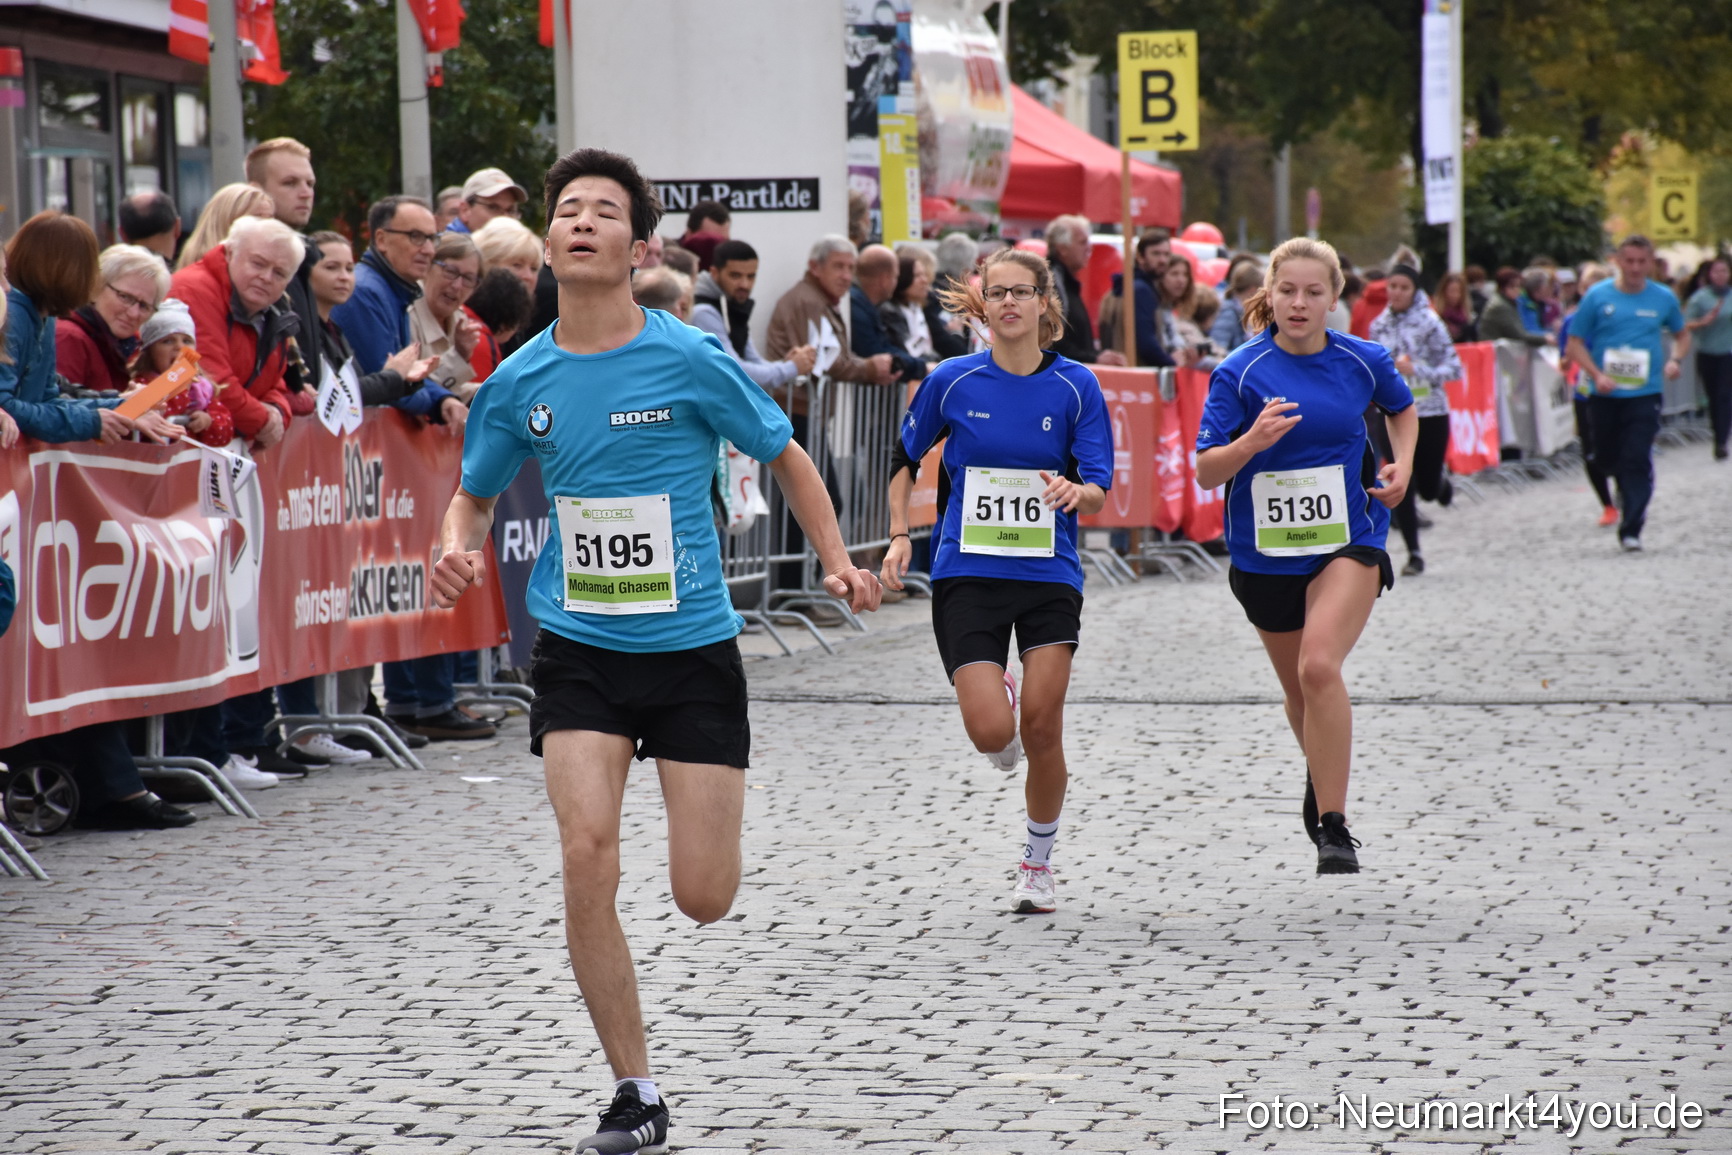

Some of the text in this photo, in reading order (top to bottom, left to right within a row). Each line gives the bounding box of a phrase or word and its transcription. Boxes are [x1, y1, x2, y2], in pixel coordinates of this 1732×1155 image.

[1128, 38, 1187, 59] Block
[1141, 70, 1177, 124] B
[656, 181, 811, 210] INI-Partl.de
[1662, 191, 1685, 224] C
[609, 408, 673, 426] BOCK
[975, 411, 990, 419] JAKO
[1042, 416, 1052, 432] 6
[1286, 477, 1317, 486] BOCK
[592, 508, 634, 519] BOCK
[976, 495, 1041, 522] 5116
[1268, 494, 1333, 523] 5130
[997, 531, 1019, 541] Jana
[1286, 530, 1318, 542] Amelie
[575, 533, 654, 569] 5195
[569, 578, 669, 594] Mohamad Ghasem
